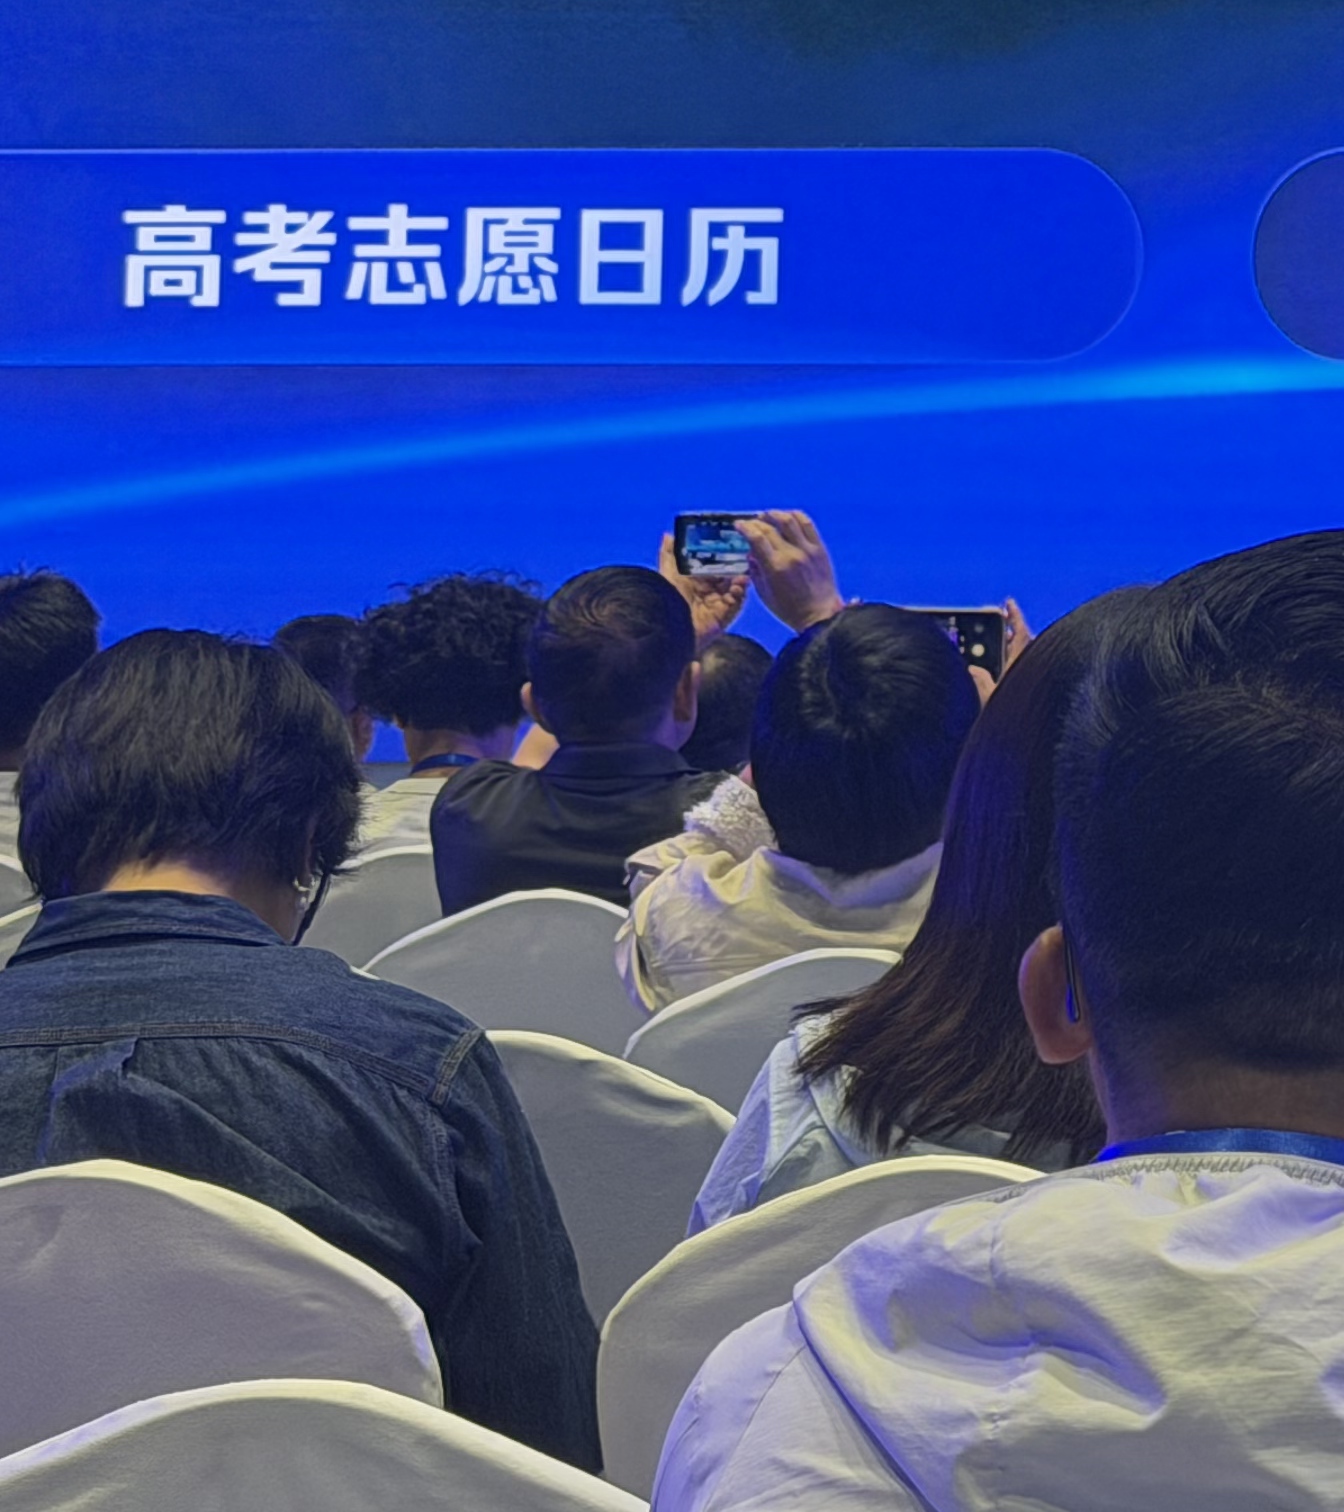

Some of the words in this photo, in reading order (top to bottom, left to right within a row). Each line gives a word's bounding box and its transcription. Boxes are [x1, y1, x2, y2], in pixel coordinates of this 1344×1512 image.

[122, 203, 783, 307] 高考志愿日历
